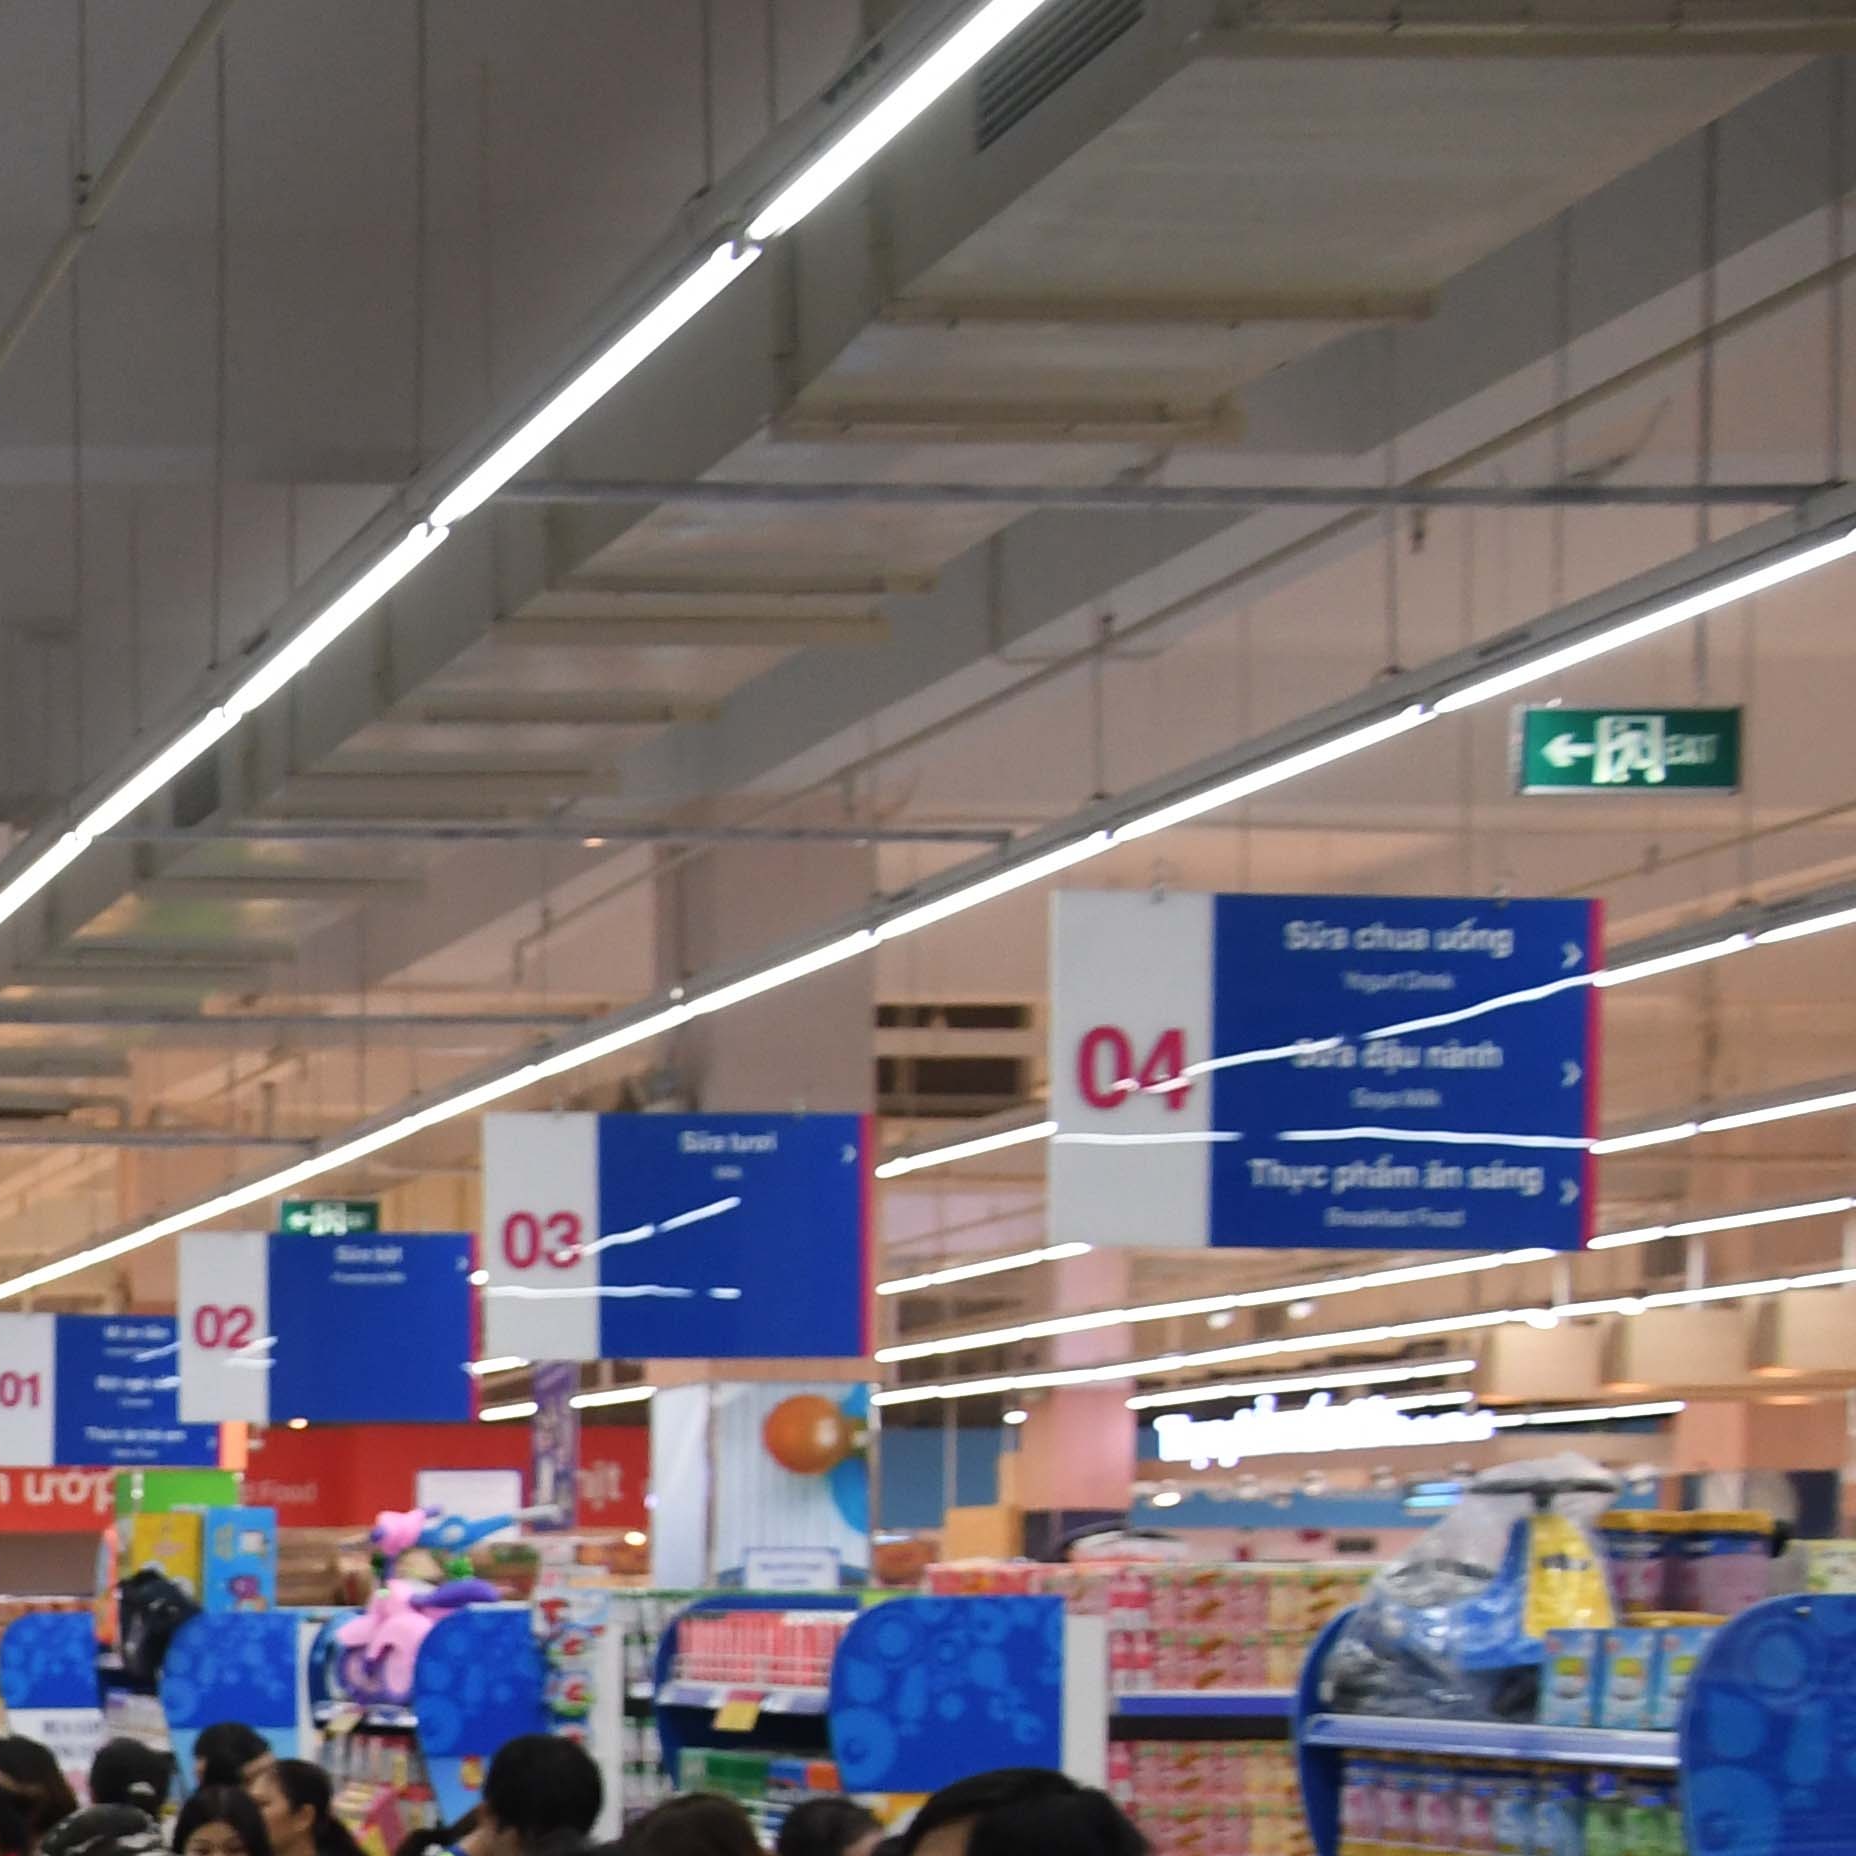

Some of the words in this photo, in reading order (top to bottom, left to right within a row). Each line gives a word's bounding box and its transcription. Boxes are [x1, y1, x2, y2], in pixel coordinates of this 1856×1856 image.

[1352, 922, 1430, 951] chua
[1078, 1026, 1187, 1112] 04
[502, 1210, 584, 1270] 03
[194, 1304, 256, 1349] 02
